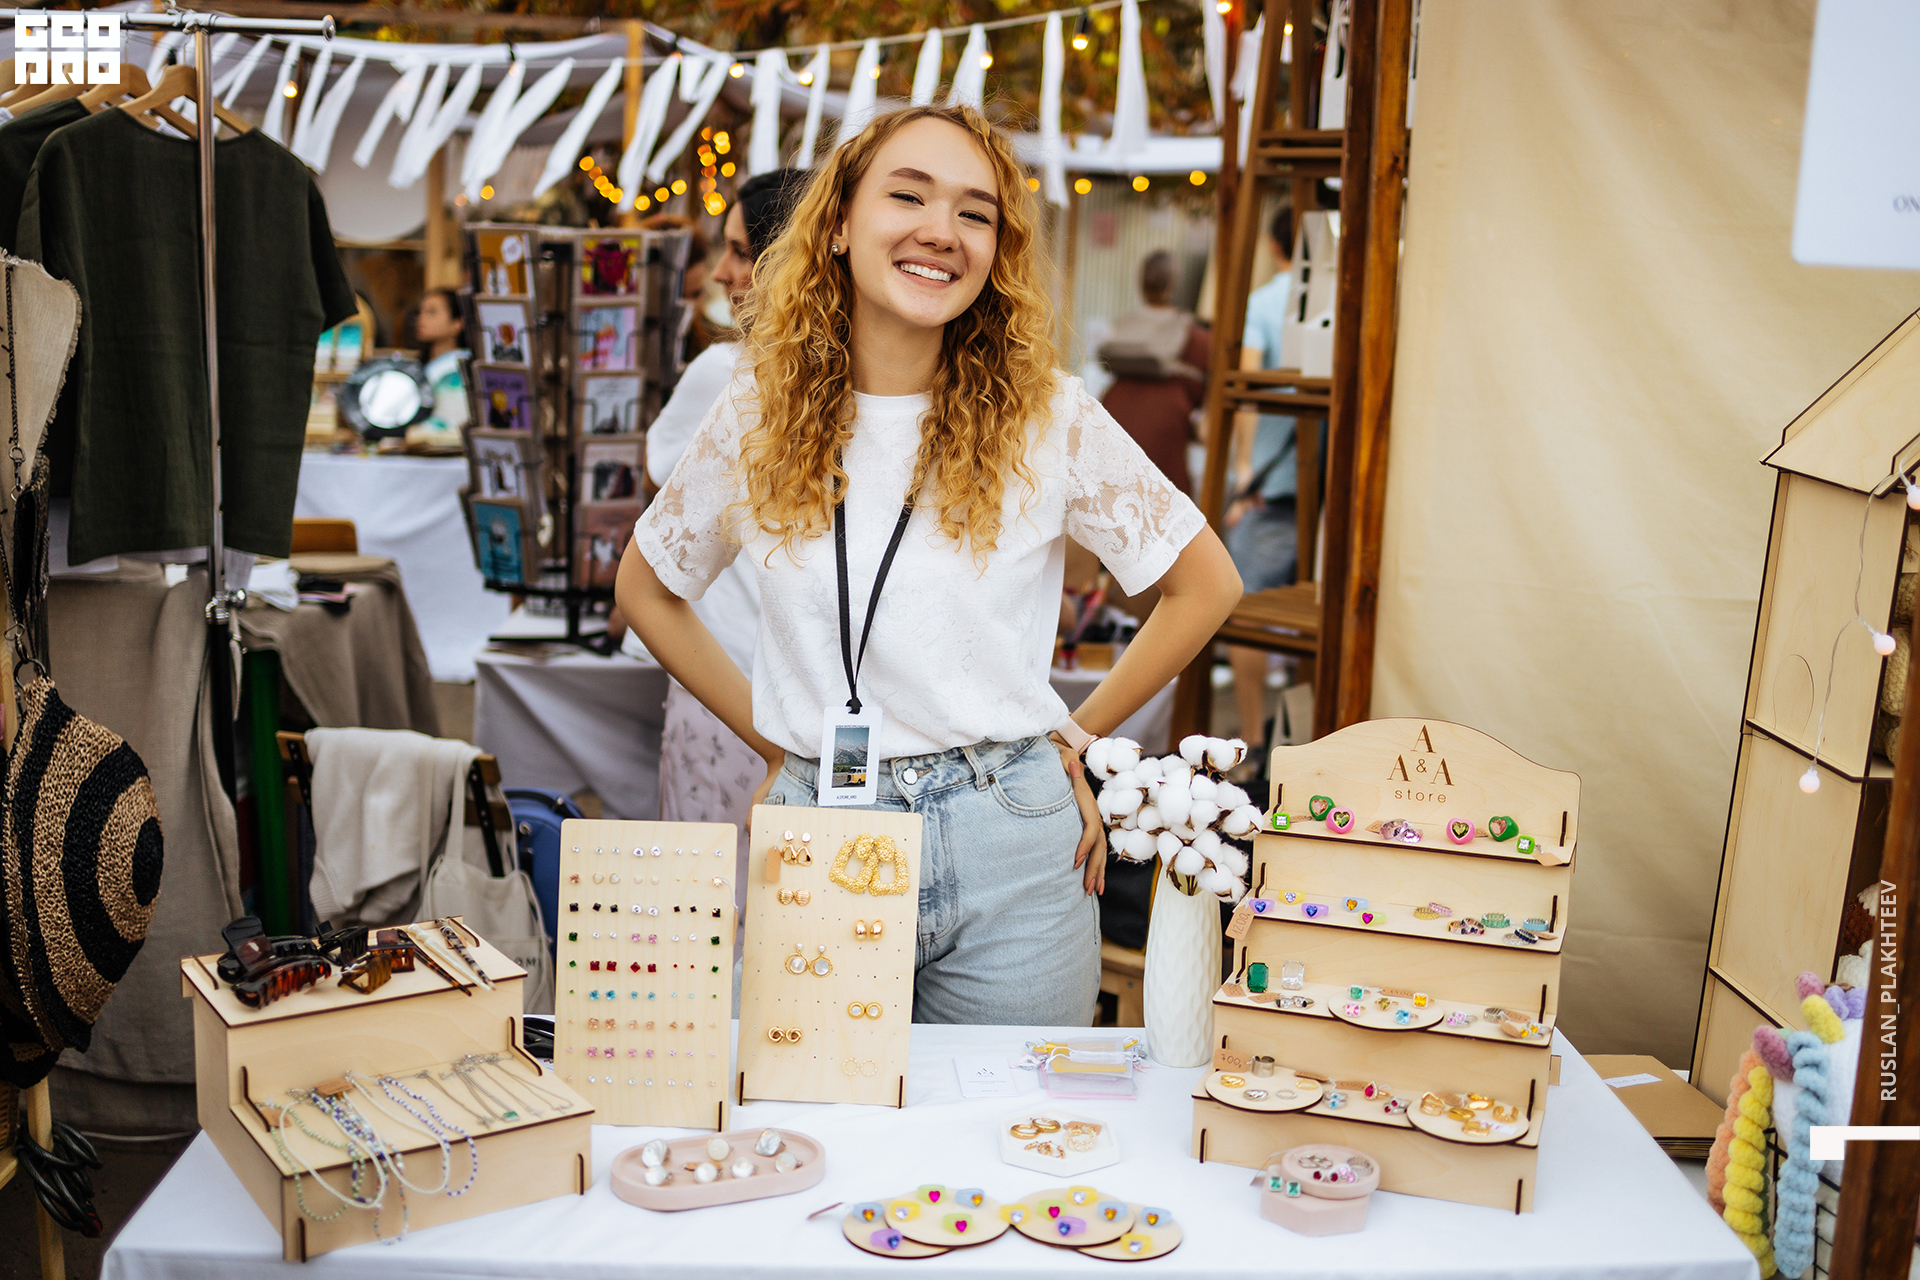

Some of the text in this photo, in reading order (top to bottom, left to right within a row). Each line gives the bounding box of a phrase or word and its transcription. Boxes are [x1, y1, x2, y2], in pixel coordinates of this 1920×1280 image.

[1410, 724, 1436, 754] A
[1386, 754, 1455, 786] A & A
[1394, 788, 1447, 804] store
